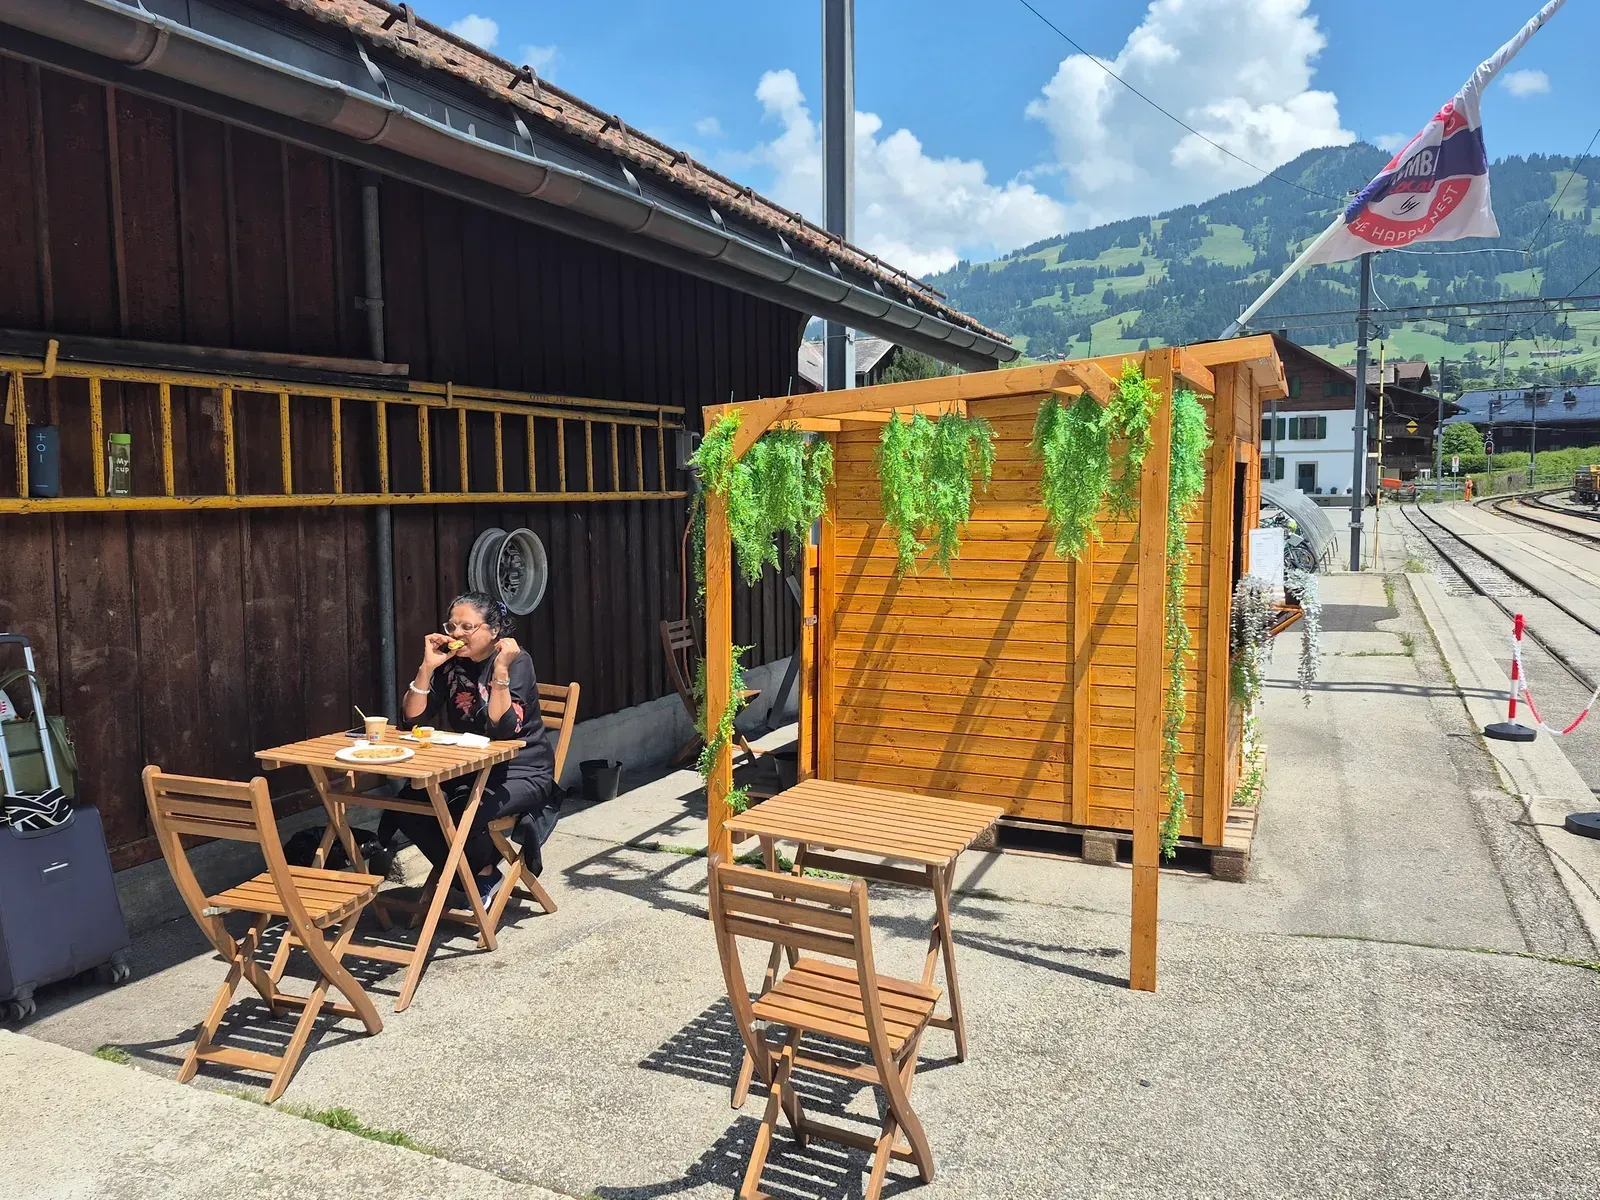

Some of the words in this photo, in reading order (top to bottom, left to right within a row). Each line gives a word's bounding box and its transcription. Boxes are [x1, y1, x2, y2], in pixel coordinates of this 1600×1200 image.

[1351, 216, 1371, 233] HE
[1371, 223, 1427, 242] HAPPY
[1429, 184, 1458, 223] NEST
[116, 457, 129, 467] My
[115, 466, 130, 475] cup
